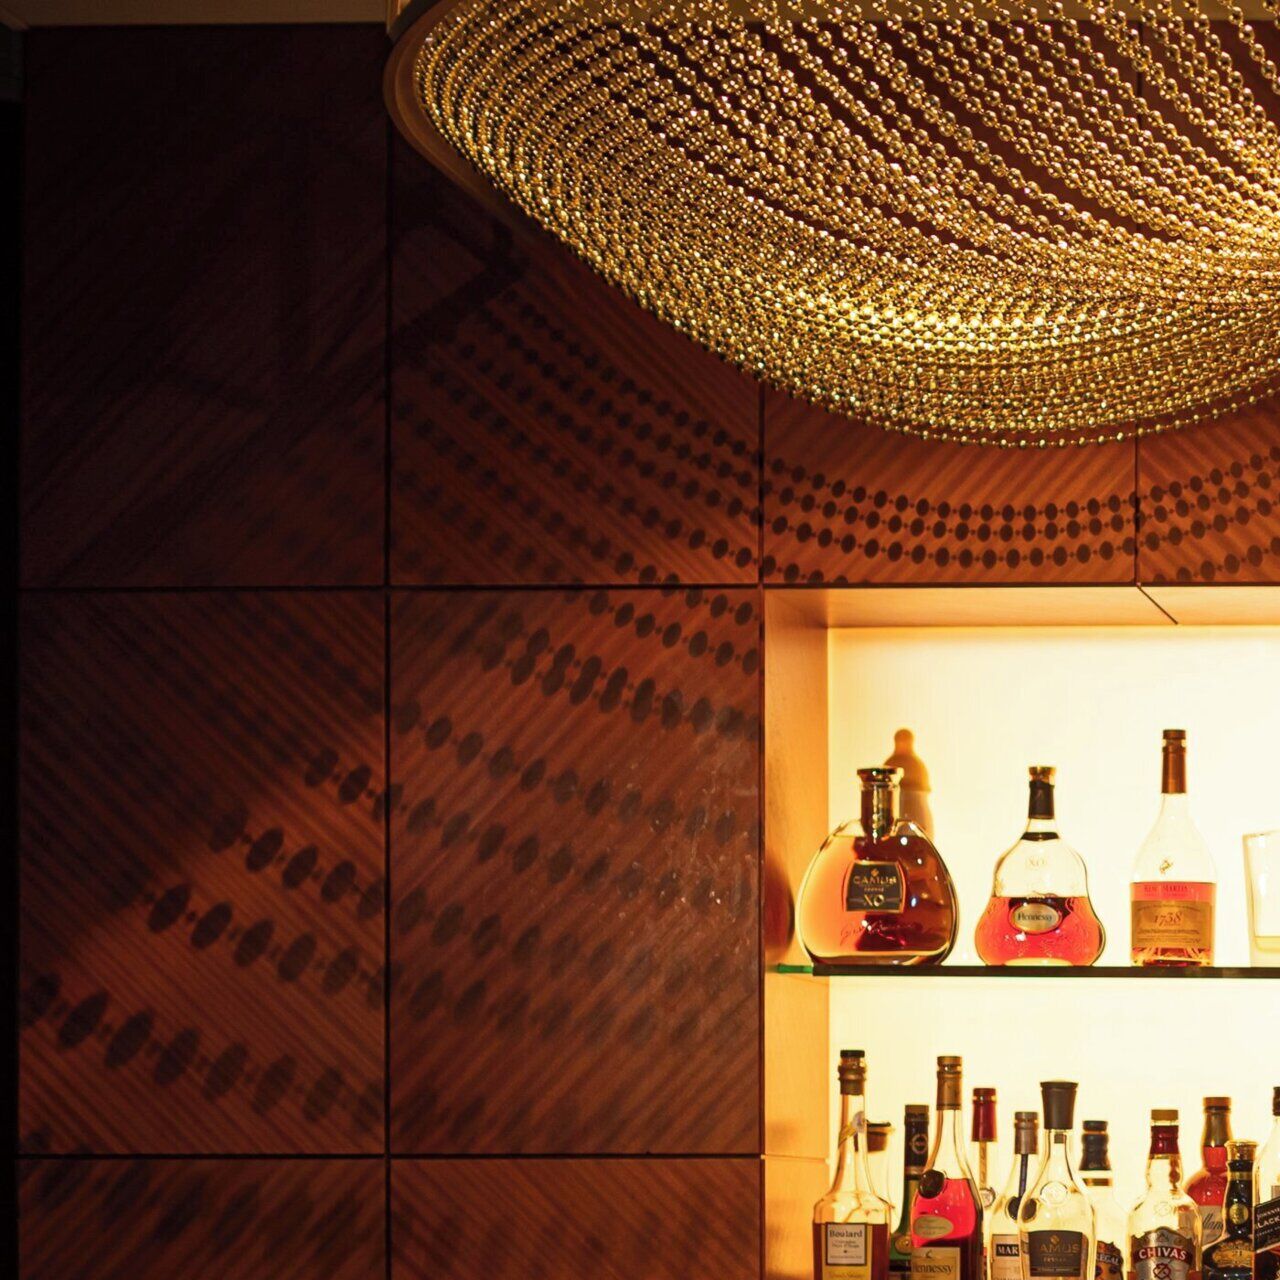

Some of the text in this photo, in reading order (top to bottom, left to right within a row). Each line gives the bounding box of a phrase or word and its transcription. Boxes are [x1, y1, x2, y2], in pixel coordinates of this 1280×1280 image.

[1154, 910, 1183, 927] 1738
[1255, 1216, 1280, 1230] LACK
[830, 1230, 863, 1238] Boulard
[1138, 1247, 1188, 1261] CHIVAS
